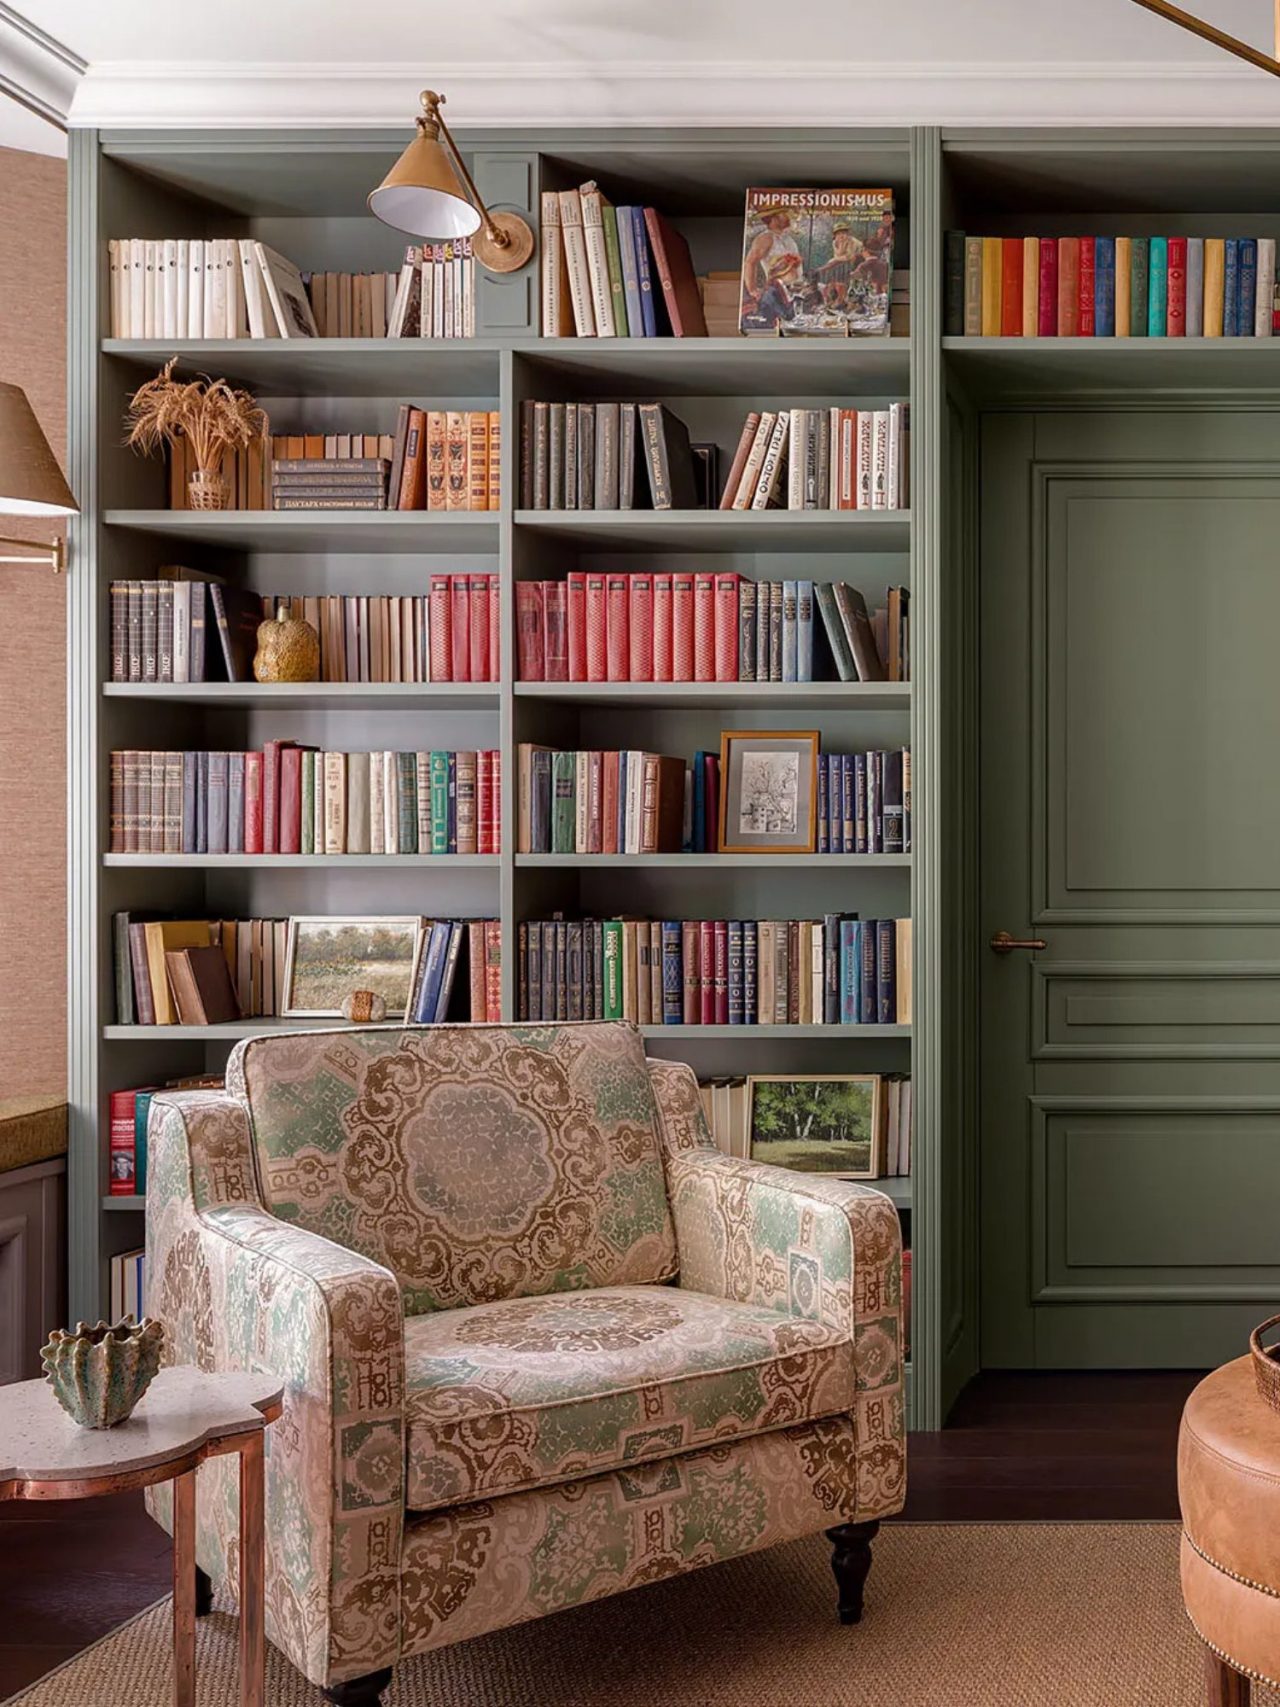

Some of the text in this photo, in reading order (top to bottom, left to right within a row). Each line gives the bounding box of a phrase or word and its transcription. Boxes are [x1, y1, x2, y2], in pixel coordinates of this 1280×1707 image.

[753, 193, 885, 206] IMPRESSIONISMUS
[862, 420, 871, 472] ПЛУТАРХ
[877, 420, 886, 472] ПЛУТАРХ
[888, 818, 898, 838] 2
